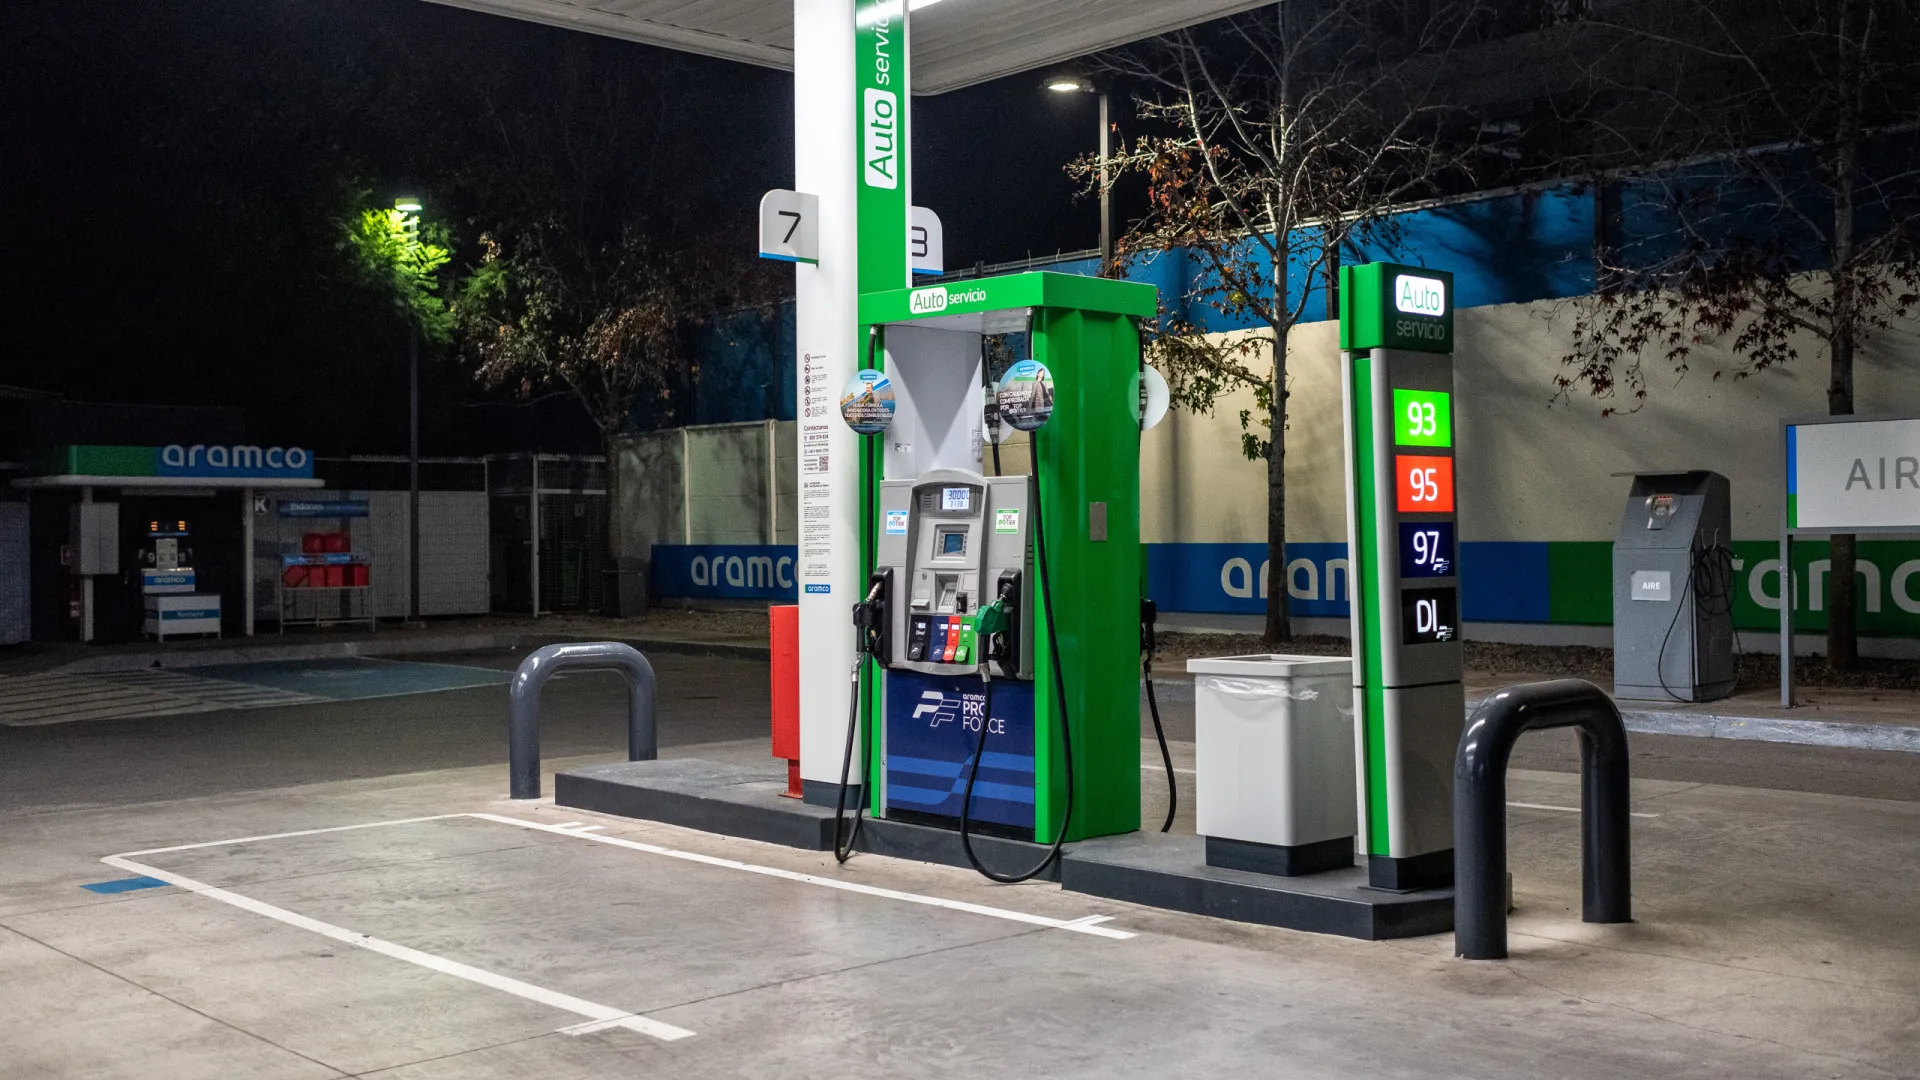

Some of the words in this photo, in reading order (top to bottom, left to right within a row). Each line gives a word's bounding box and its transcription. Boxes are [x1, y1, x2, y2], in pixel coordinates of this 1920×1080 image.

[868, 98, 893, 180] Auto
[778, 210, 801, 243] 7
[914, 293, 944, 310] Auto
[949, 288, 986, 304] servicio
[1401, 281, 1439, 311] Auto
[1396, 318, 1445, 340] servicio
[1407, 402, 1436, 436] 93
[162, 444, 307, 469] aramco
[1409, 467, 1438, 502] 95
[1413, 530, 1440, 565] 97
[691, 555, 798, 588] aramc
[1643, 582, 1661, 590] AIRE
[963, 716, 1005, 734] FOCE
